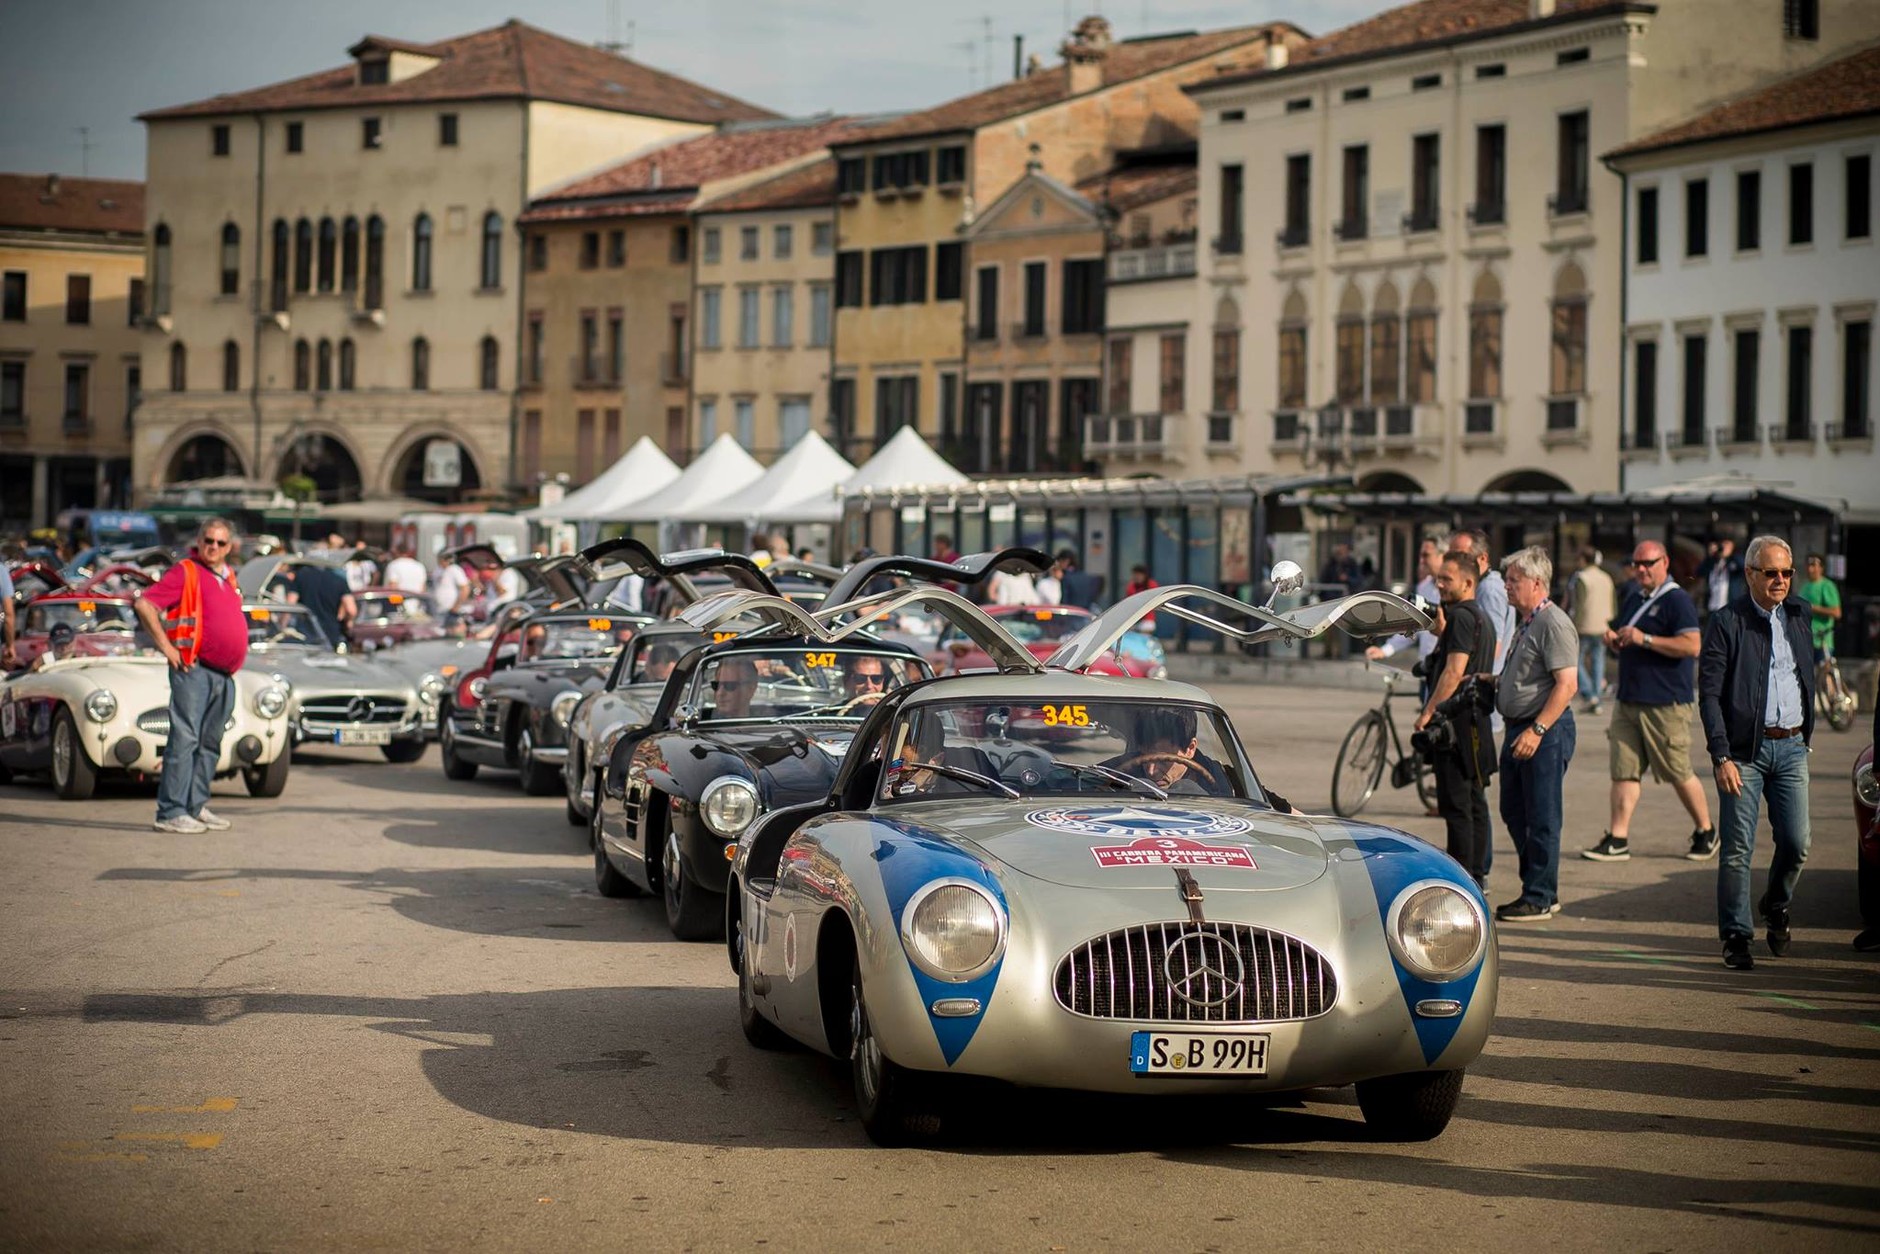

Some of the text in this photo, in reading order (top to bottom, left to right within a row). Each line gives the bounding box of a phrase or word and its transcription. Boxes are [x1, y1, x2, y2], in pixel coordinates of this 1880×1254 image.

[805, 652, 837, 668] 347
[1042, 704, 1089, 727] 345
[1156, 839, 1178, 848] 3
[1165, 850, 1247, 860] PANAMERICANA
[1152, 1038, 1266, 1069] S B 99H
[1136, 1056, 1144, 1066] D
